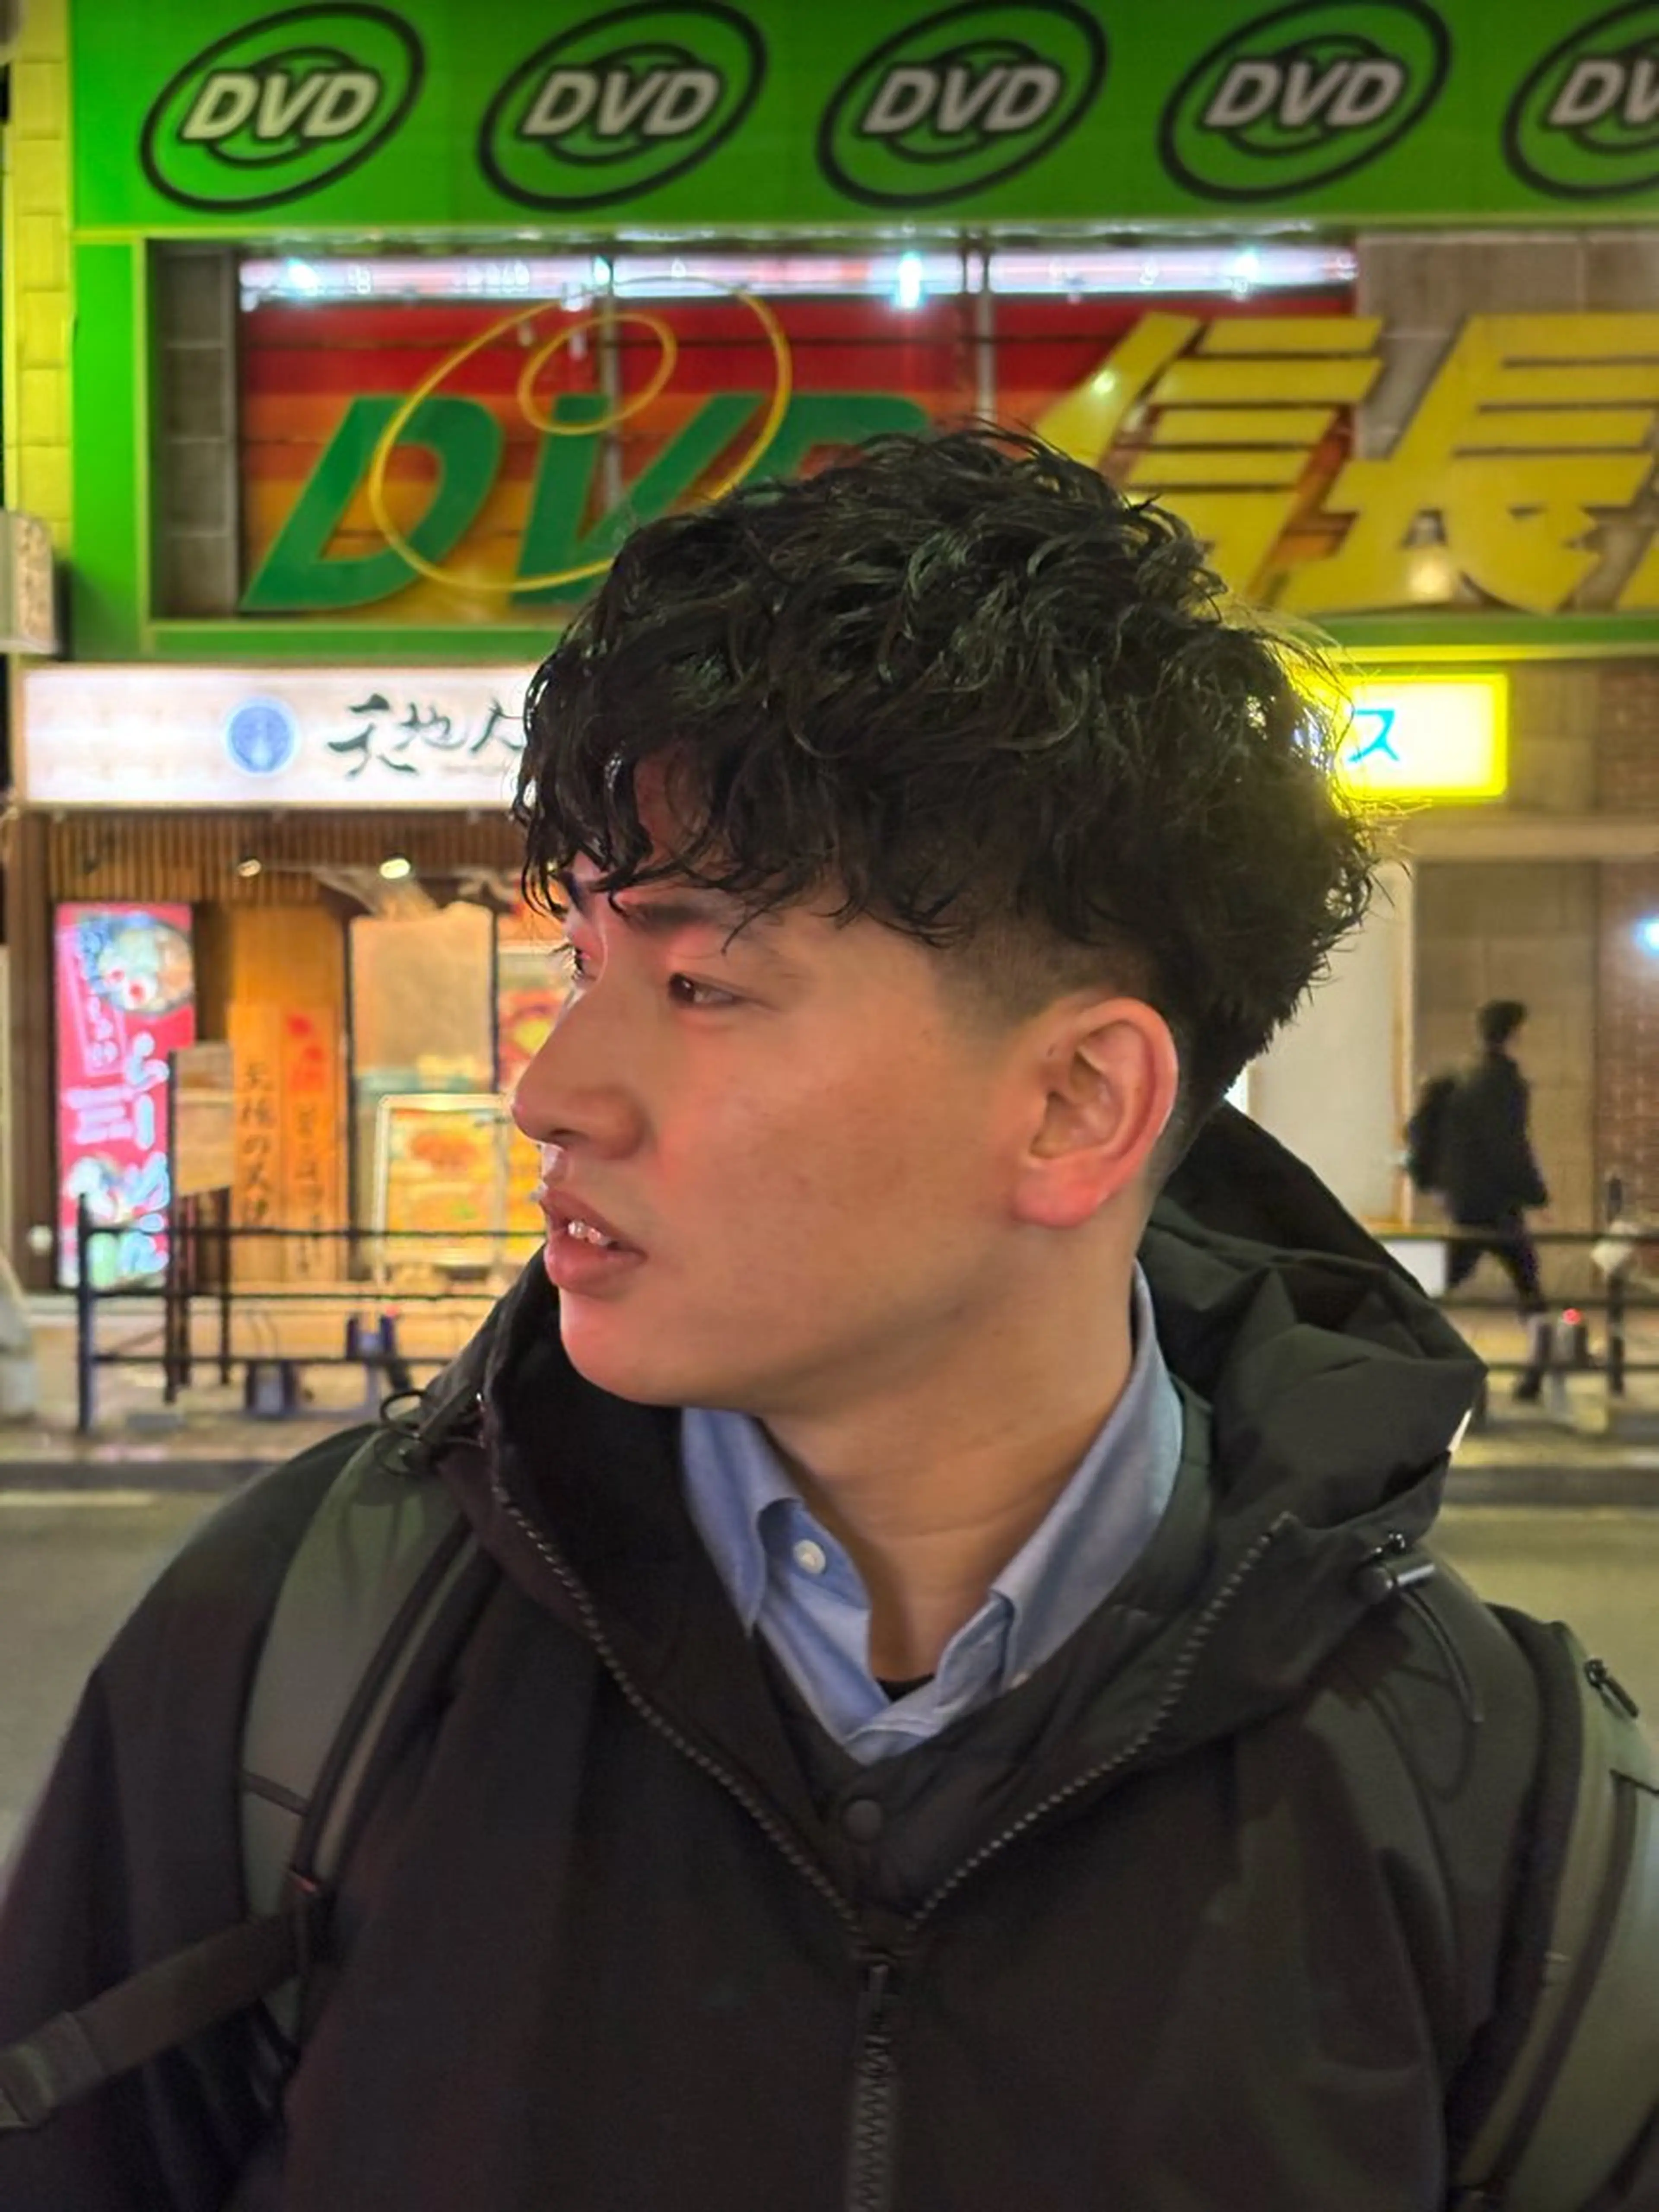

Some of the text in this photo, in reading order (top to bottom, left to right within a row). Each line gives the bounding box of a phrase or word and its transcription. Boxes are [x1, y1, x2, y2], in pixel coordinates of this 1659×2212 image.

[181, 72, 378, 139] DVD
[522, 69, 720, 136] DVD
[862, 66, 1061, 133] DVD
[1204, 61, 1402, 127] DVD
[1035, 311, 1659, 614] 信長
